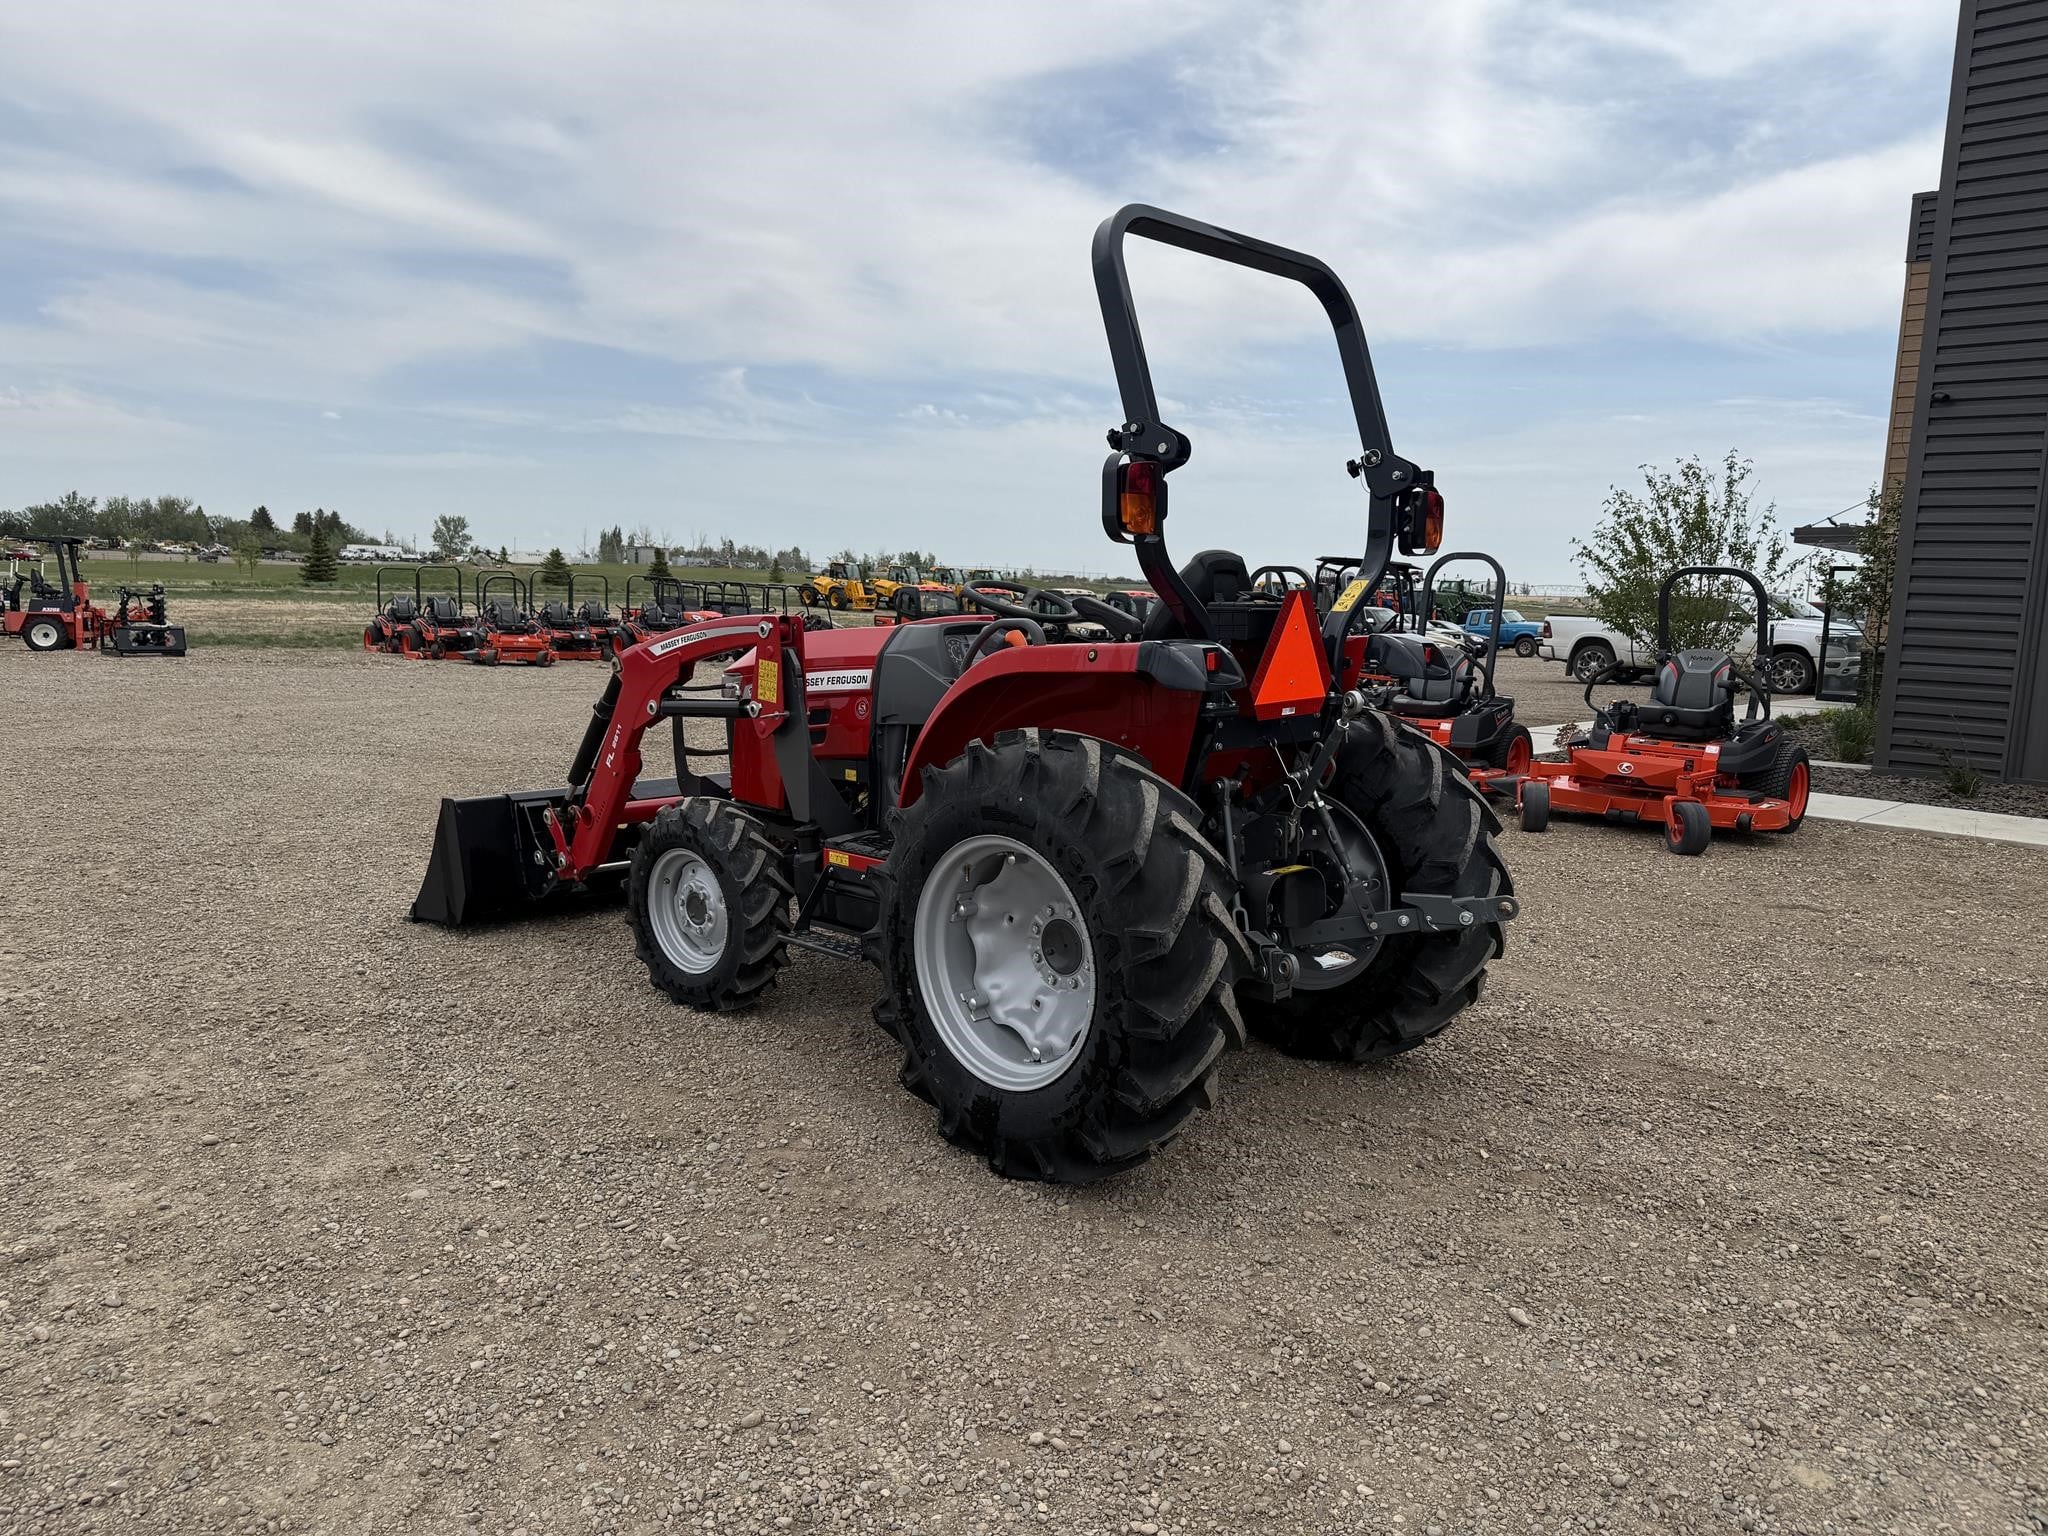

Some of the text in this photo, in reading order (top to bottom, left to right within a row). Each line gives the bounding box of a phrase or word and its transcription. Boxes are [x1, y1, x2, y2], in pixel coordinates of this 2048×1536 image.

[660, 631, 707, 651] MASSEY FERGUSON
[806, 675, 868, 686] SSEY FERGUSON
[605, 752, 615, 769] FL
